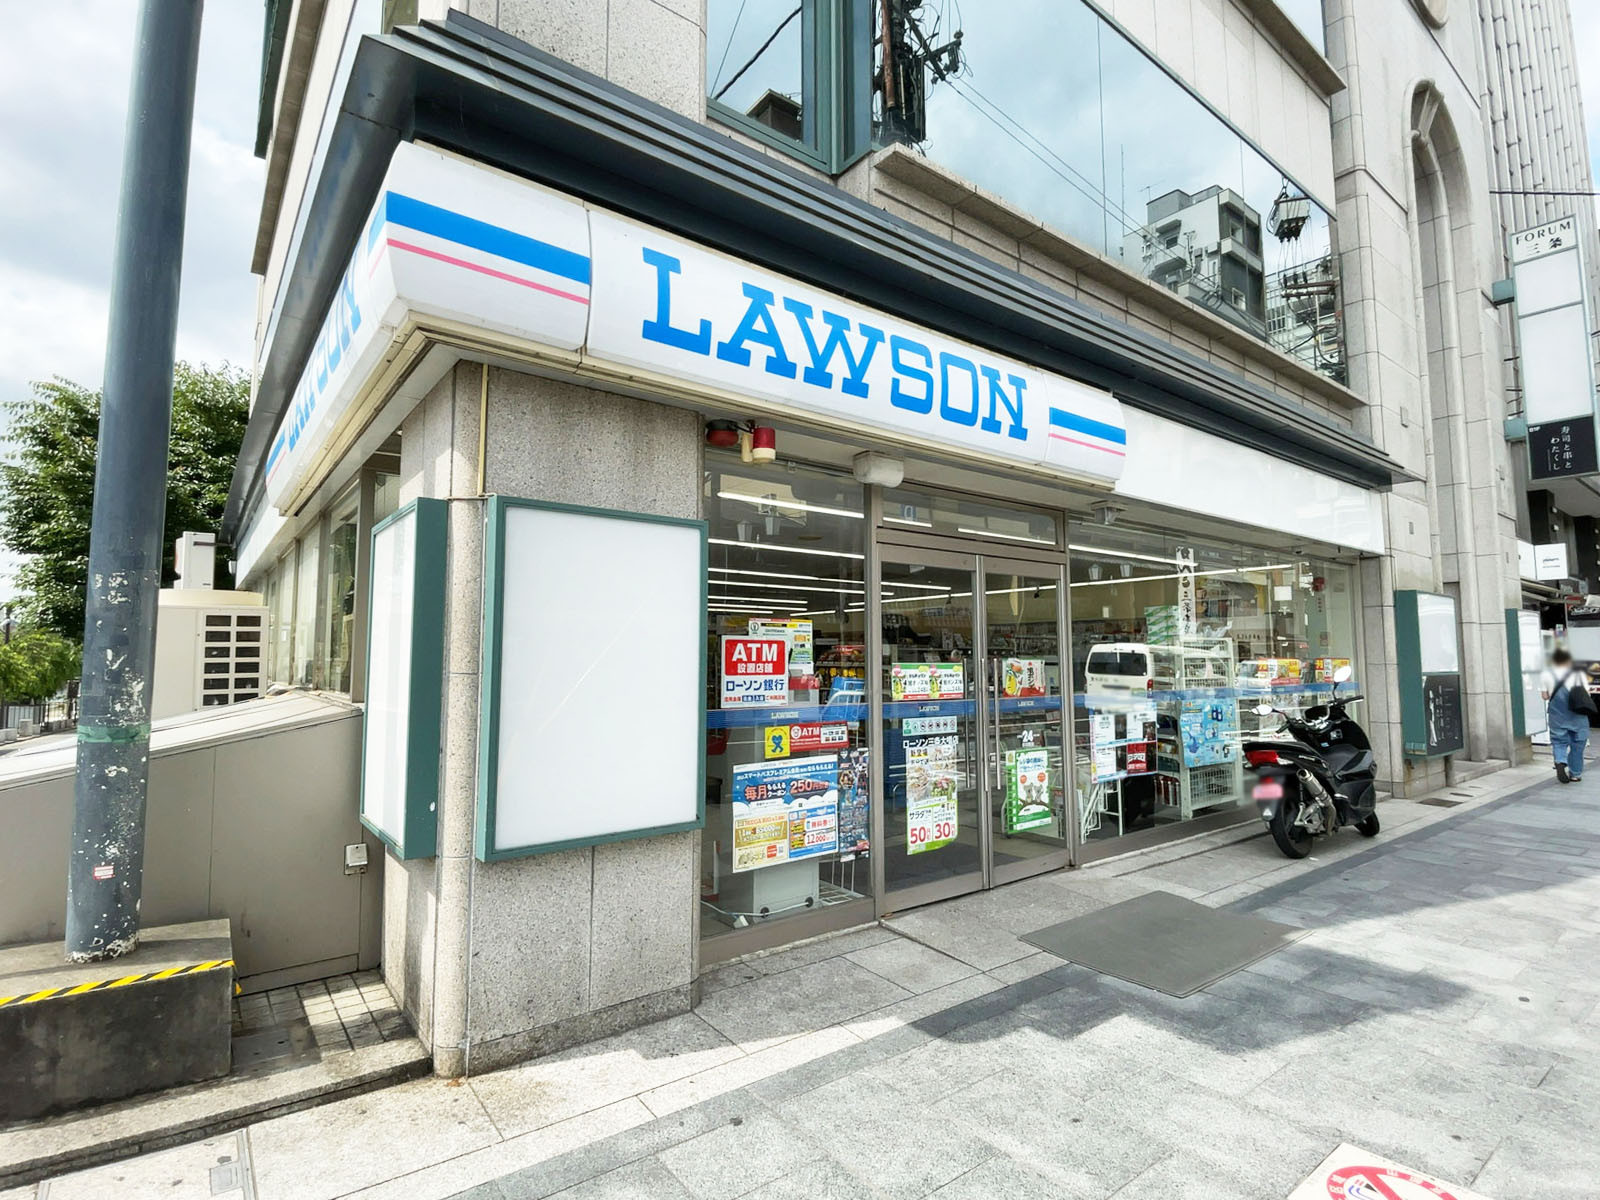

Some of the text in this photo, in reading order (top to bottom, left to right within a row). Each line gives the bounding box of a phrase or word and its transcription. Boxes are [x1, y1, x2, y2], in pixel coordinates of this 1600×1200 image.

[1515, 221, 1572, 245] FORUM
[1526, 237, 1562, 254] 三条
[642, 247, 1028, 441] LAWSON
[1550, 437, 1561, 471] わたくし
[1561, 426, 1573, 469] 寿司と串と
[732, 643, 778, 662] ATM
[737, 663, 773, 673] 設置店舗
[726, 679, 785, 692] ローソン銀行
[801, 727, 820, 737] ATM
[1022, 729, 1034, 742] 24
[745, 785, 767, 800] 毎月
